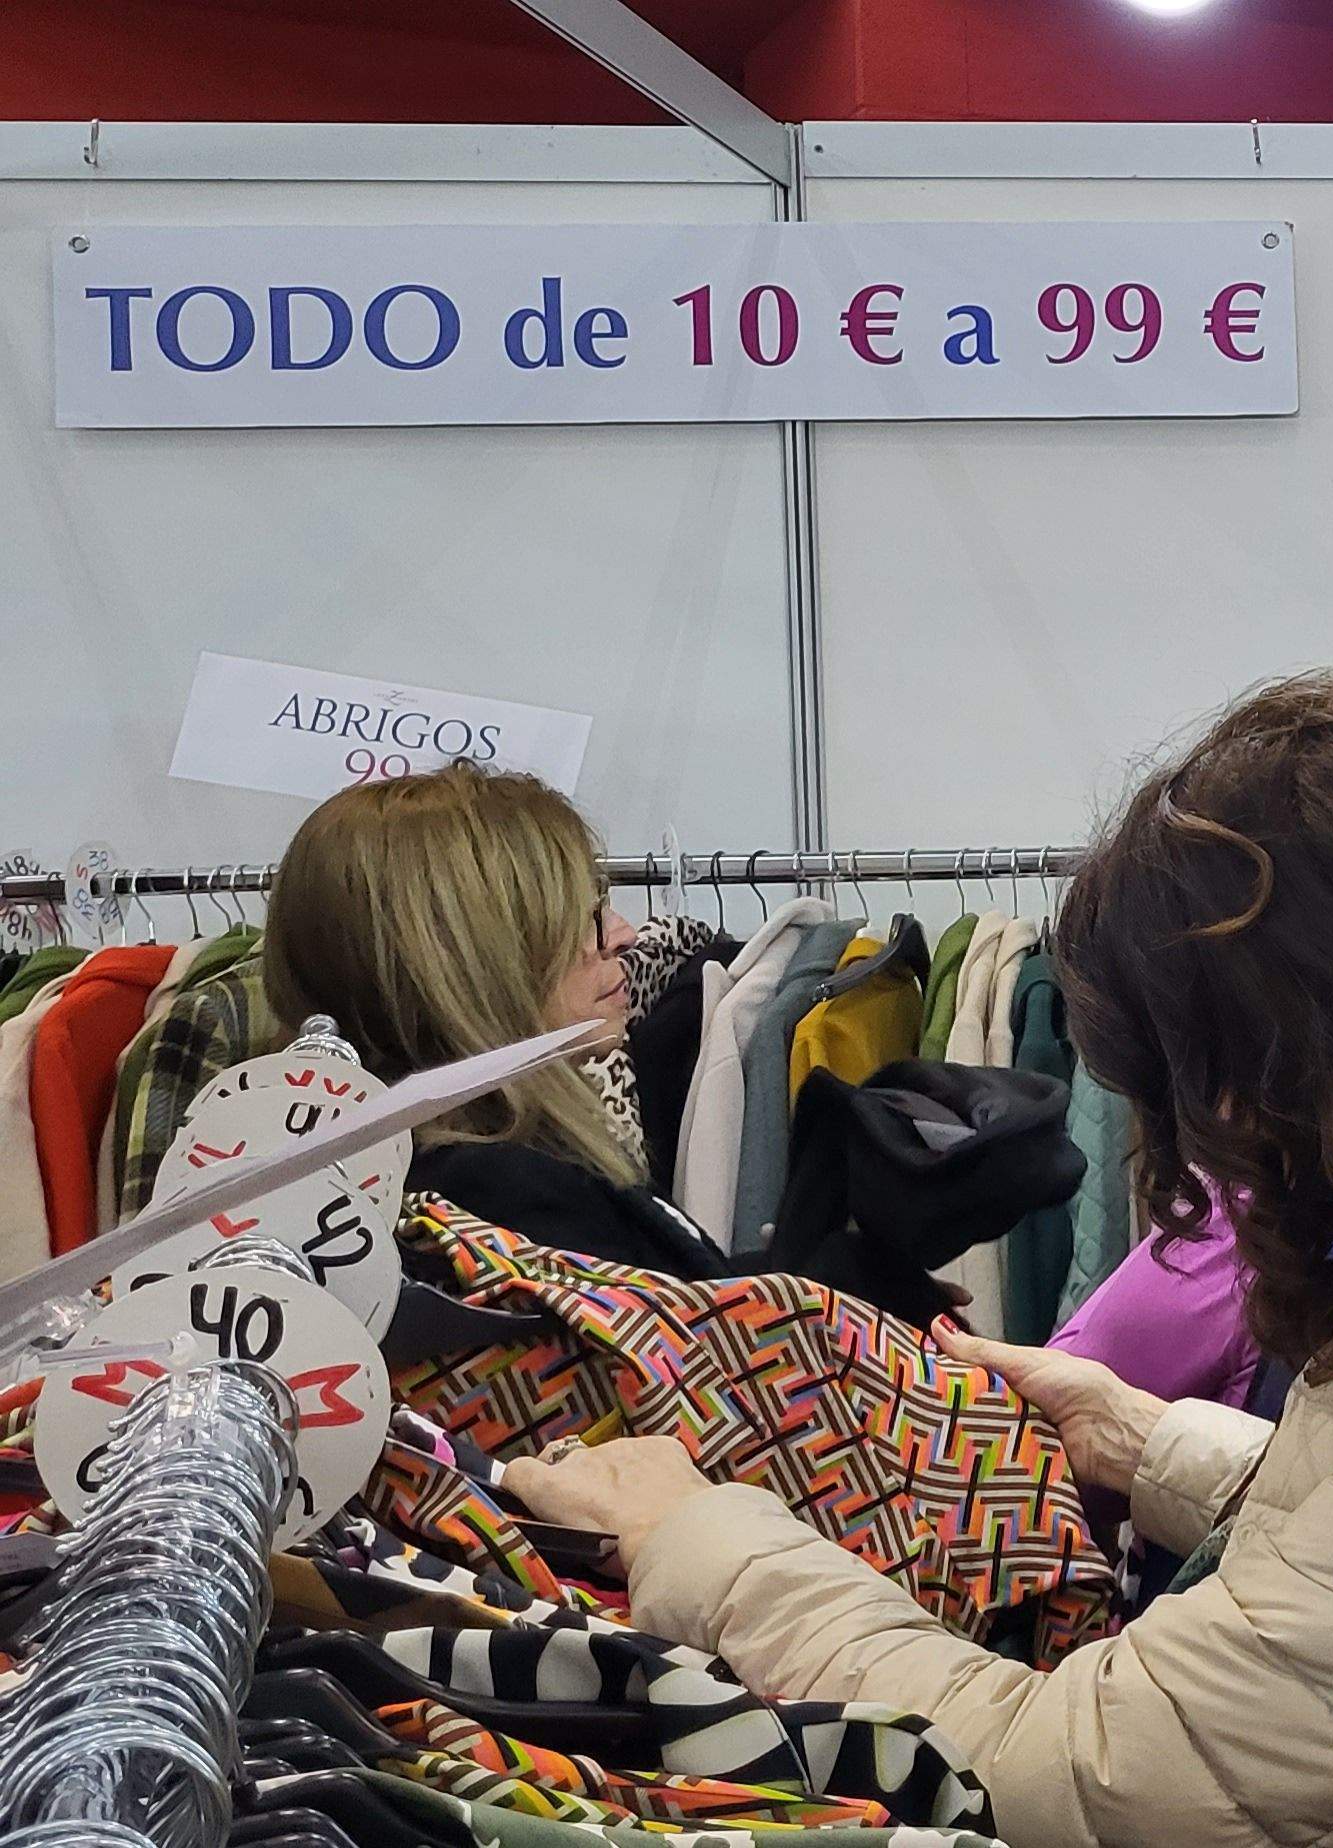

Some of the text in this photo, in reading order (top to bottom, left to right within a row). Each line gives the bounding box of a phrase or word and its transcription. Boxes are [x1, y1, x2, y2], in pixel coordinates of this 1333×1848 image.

[84, 276, 1267, 372] TODO de 10 € a 99 €
[268, 692, 502, 762] ABRIGOS
[88, 850, 109, 871] 38
[190, 1283, 284, 1362] 40
